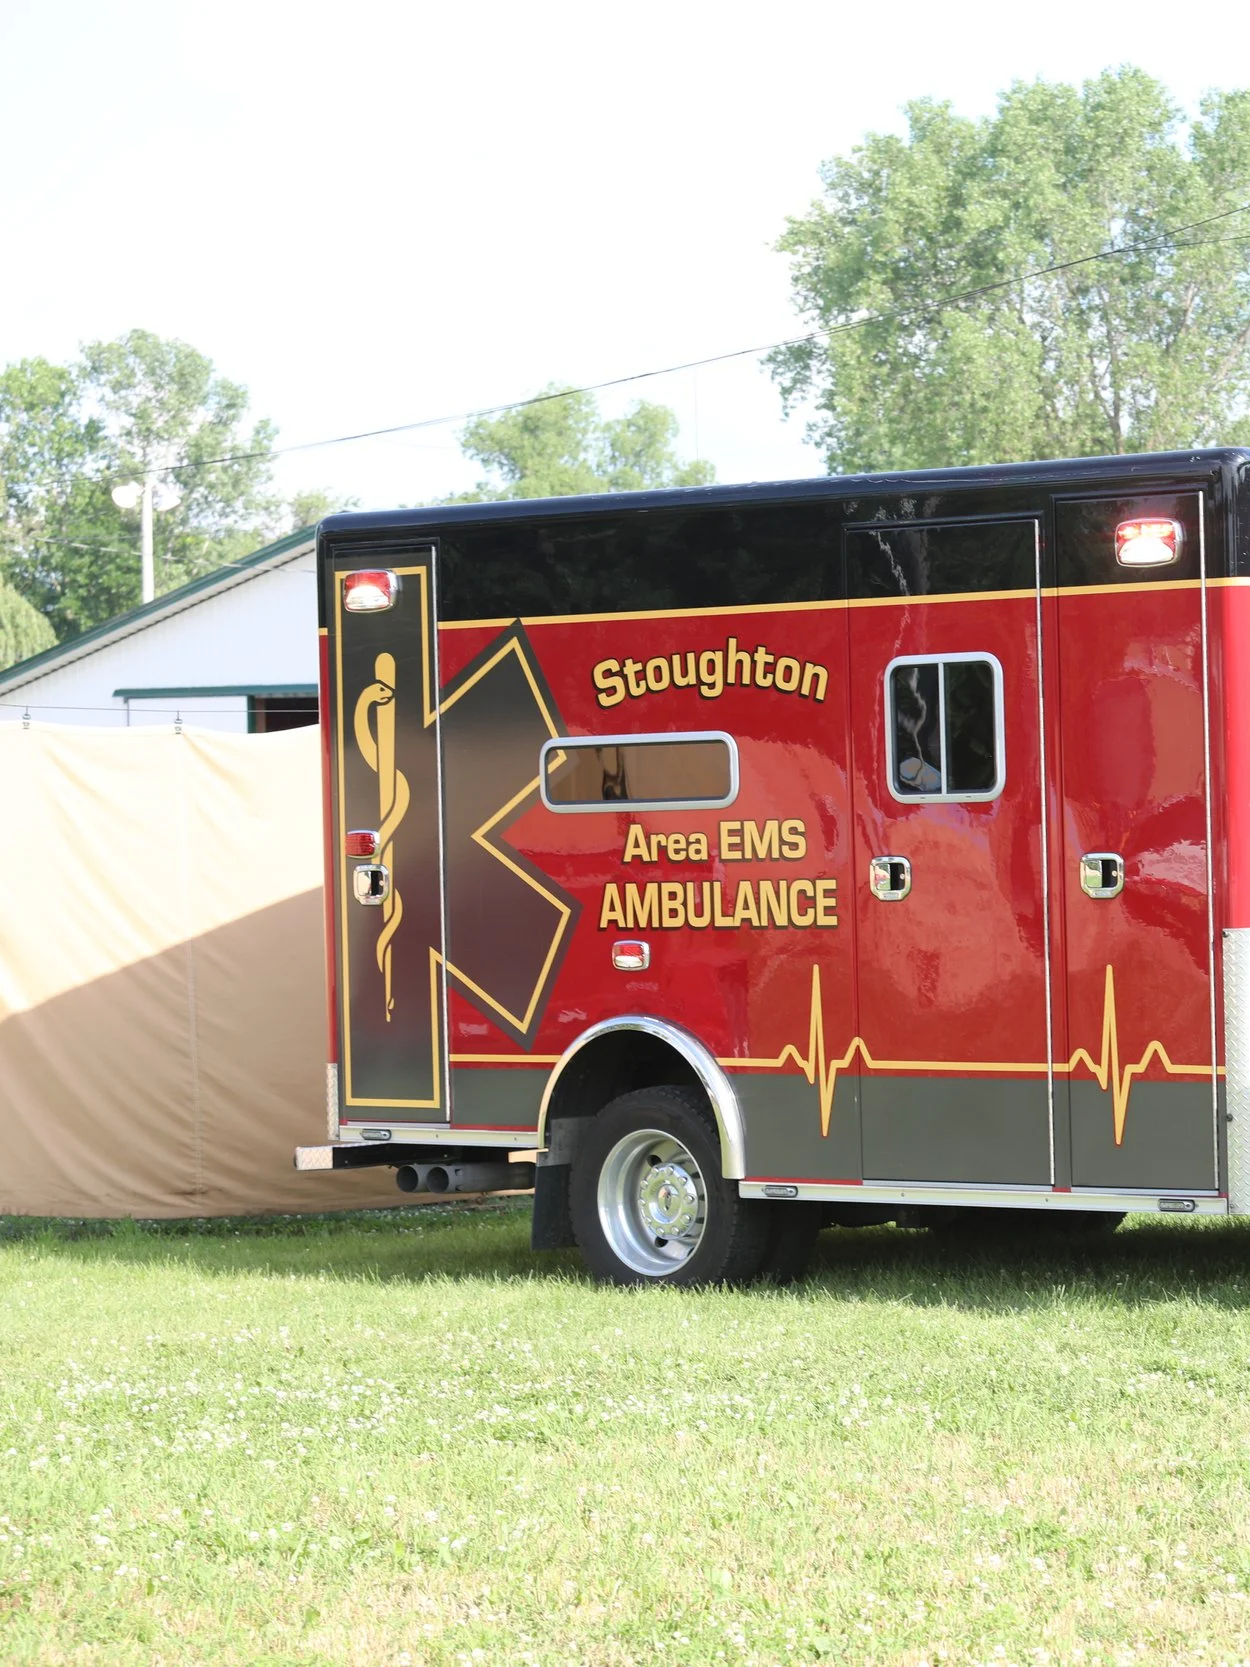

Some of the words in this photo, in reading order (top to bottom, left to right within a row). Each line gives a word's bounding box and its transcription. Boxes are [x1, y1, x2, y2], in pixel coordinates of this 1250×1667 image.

[592, 636, 829, 709] Stoughton
[622, 822, 709, 865] Area
[718, 817, 807, 863] EMS
[598, 877, 838, 930] AMBULANCE
